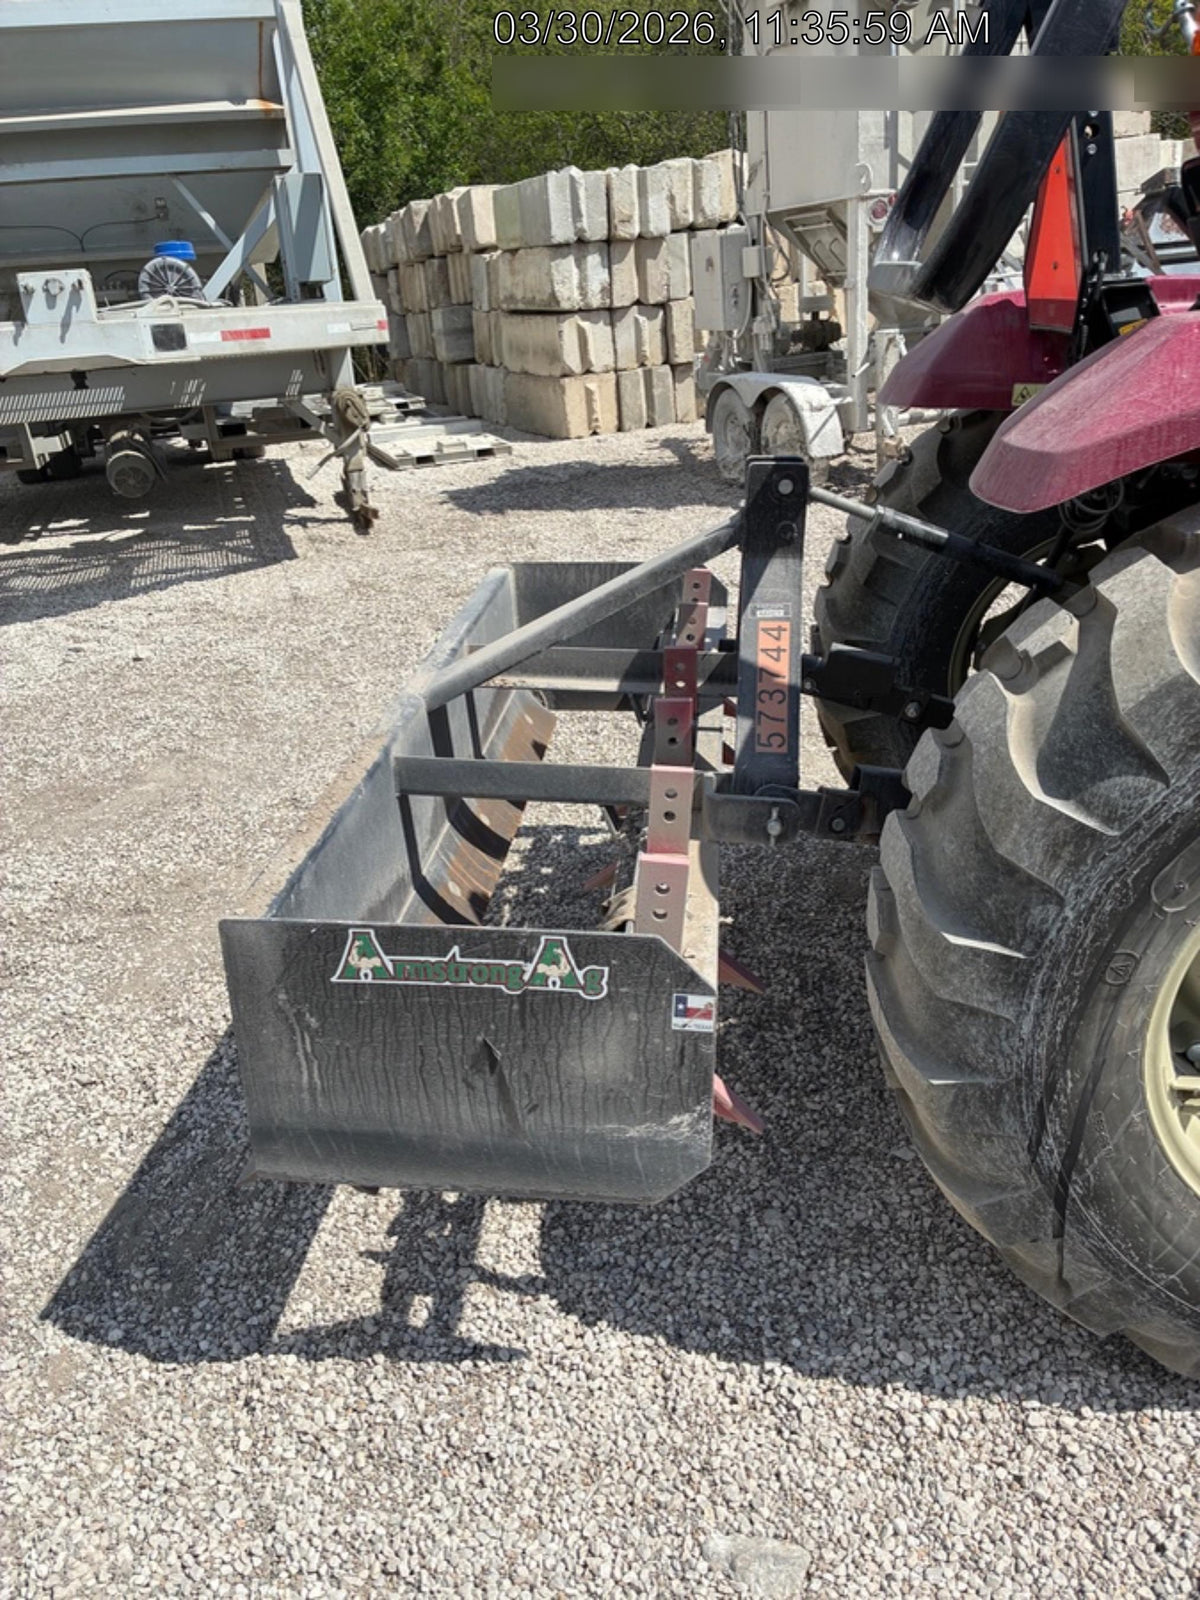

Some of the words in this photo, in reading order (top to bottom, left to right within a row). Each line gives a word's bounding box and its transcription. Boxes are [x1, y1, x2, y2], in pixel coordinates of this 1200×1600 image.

[757, 625, 788, 749] 573744
[332, 929, 527, 993] Armstrong
[525, 935, 608, 999] Ag
